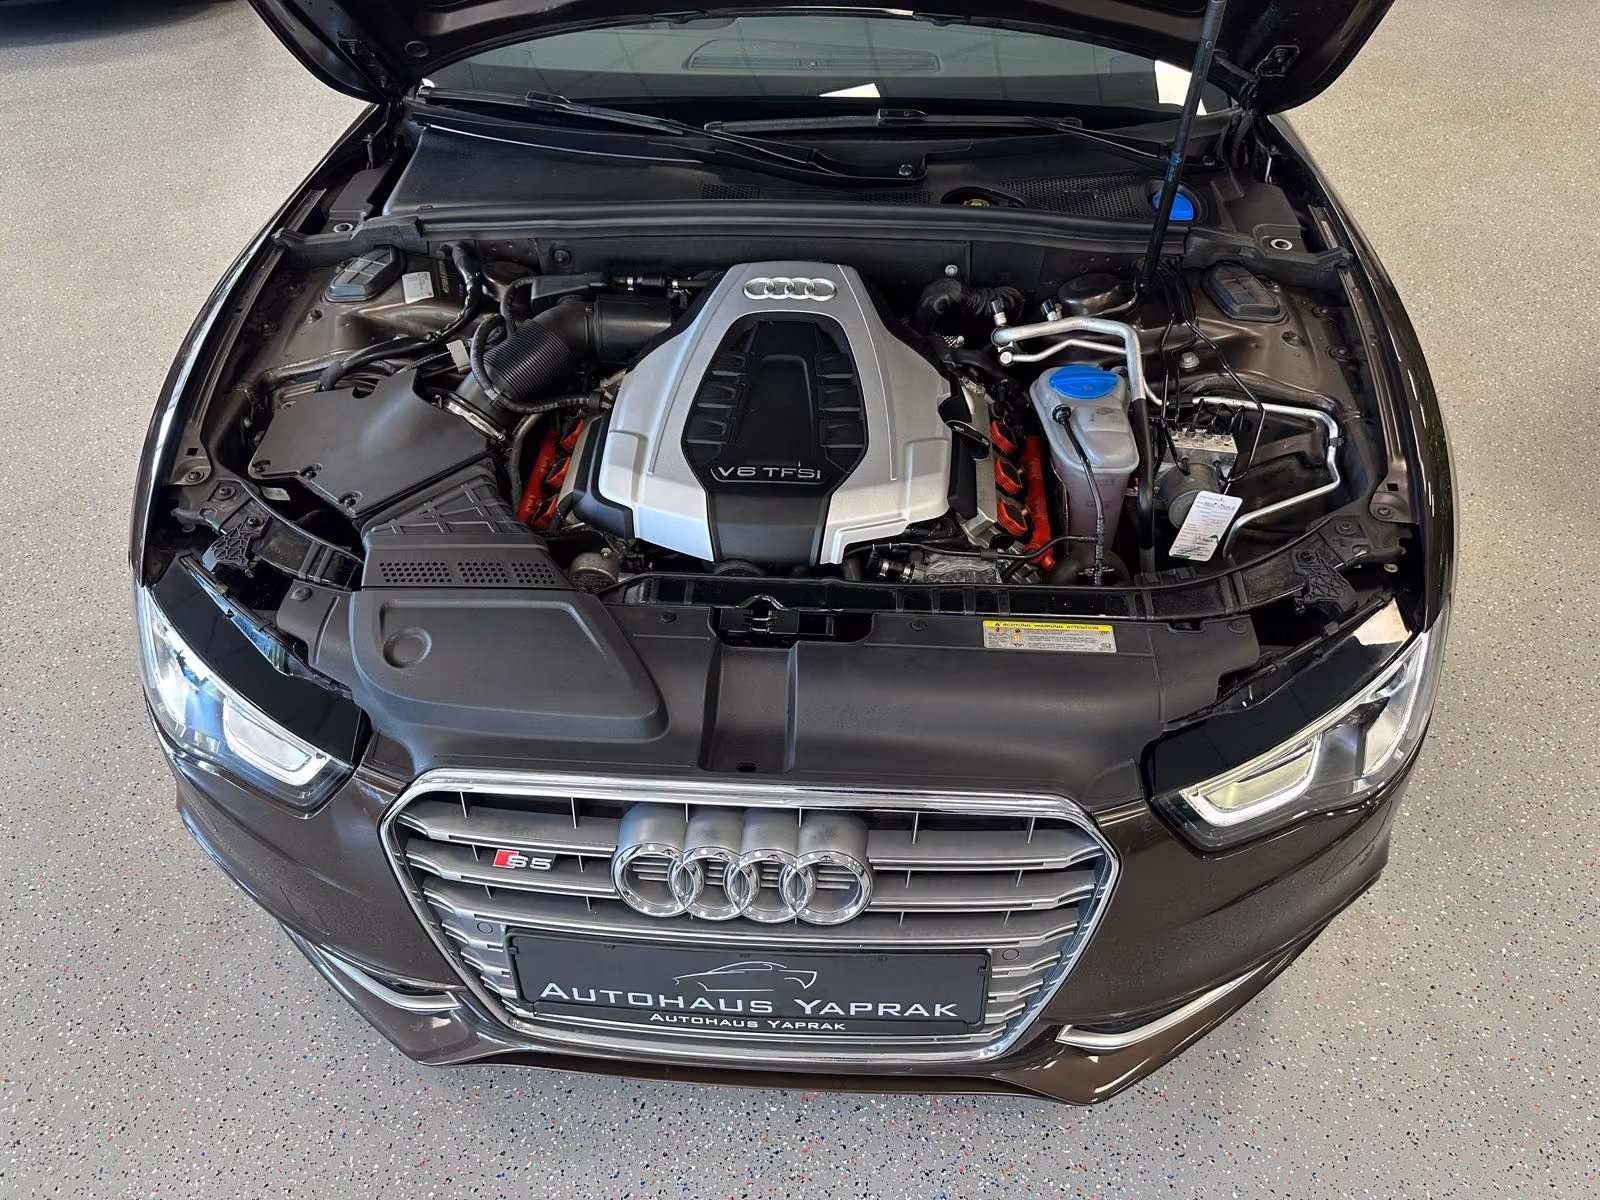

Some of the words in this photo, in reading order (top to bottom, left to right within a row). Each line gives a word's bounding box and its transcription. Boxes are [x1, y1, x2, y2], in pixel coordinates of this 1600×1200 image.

[718, 466, 756, 477] V6
[506, 855, 552, 870] S5
[540, 982, 773, 1014] AUTOHAUS
[793, 999, 959, 1018] YAPRAK
[650, 1013, 758, 1029] AUTOHAUS
[767, 1020, 846, 1031] YAPRAK
